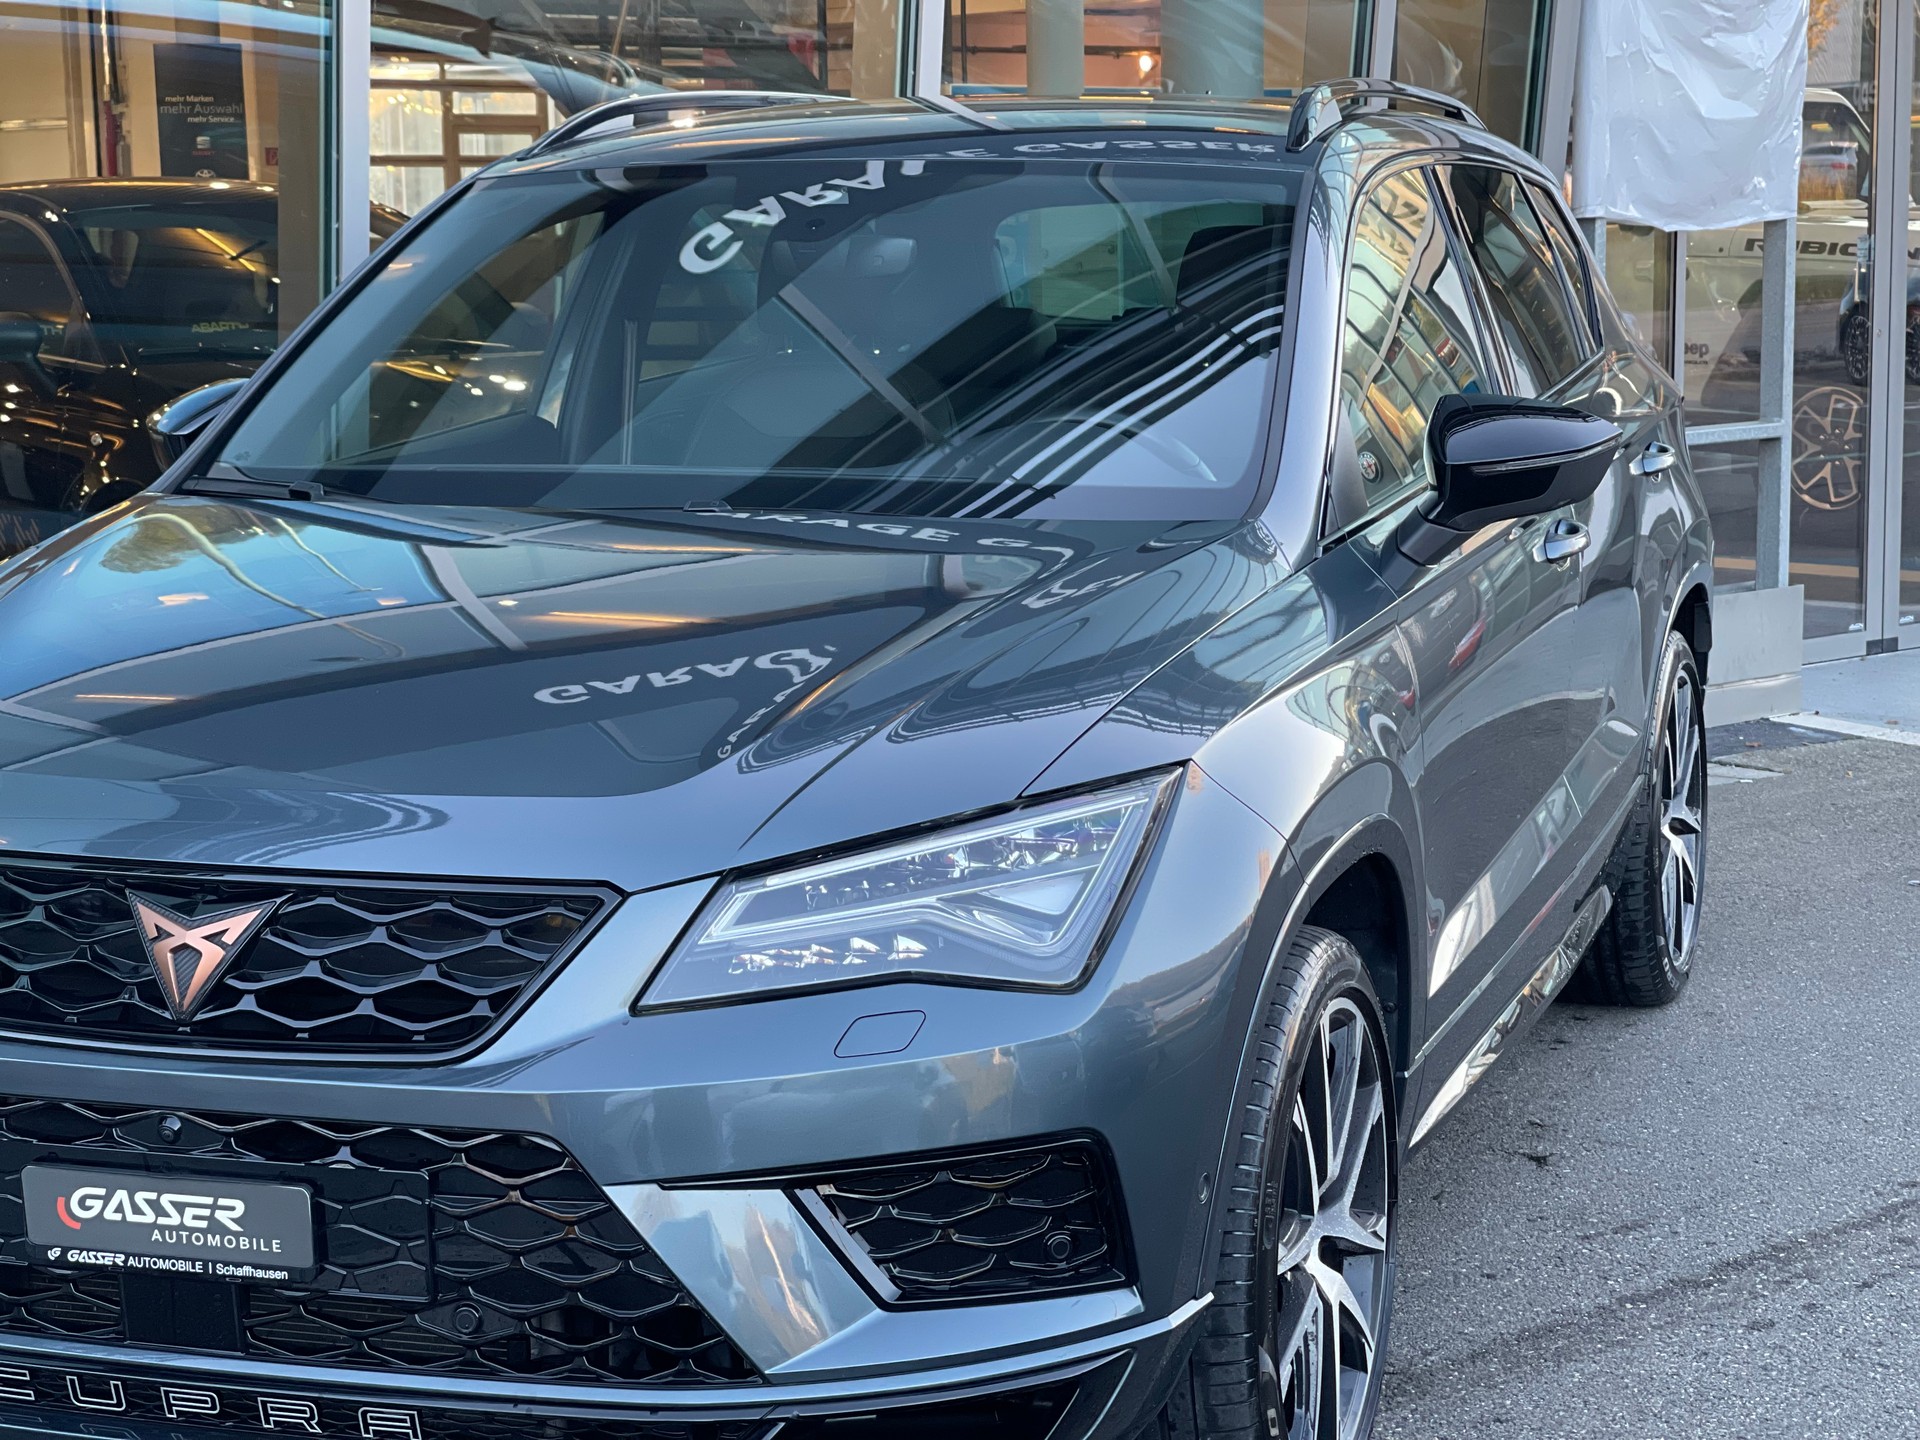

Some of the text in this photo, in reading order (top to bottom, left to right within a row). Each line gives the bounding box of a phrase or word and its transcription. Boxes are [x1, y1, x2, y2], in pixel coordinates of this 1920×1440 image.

[160, 103, 243, 114] mehr Auswahl
[1744, 238, 1920, 260] RBIC
[69, 1186, 246, 1232] GASSER
[151, 1228, 282, 1253] AUTOMOBILE
[66, 1249, 125, 1266] GASSER
[127, 1256, 203, 1273] AUTOMOBILE
[215, 1263, 288, 1280] Schaffhausen
